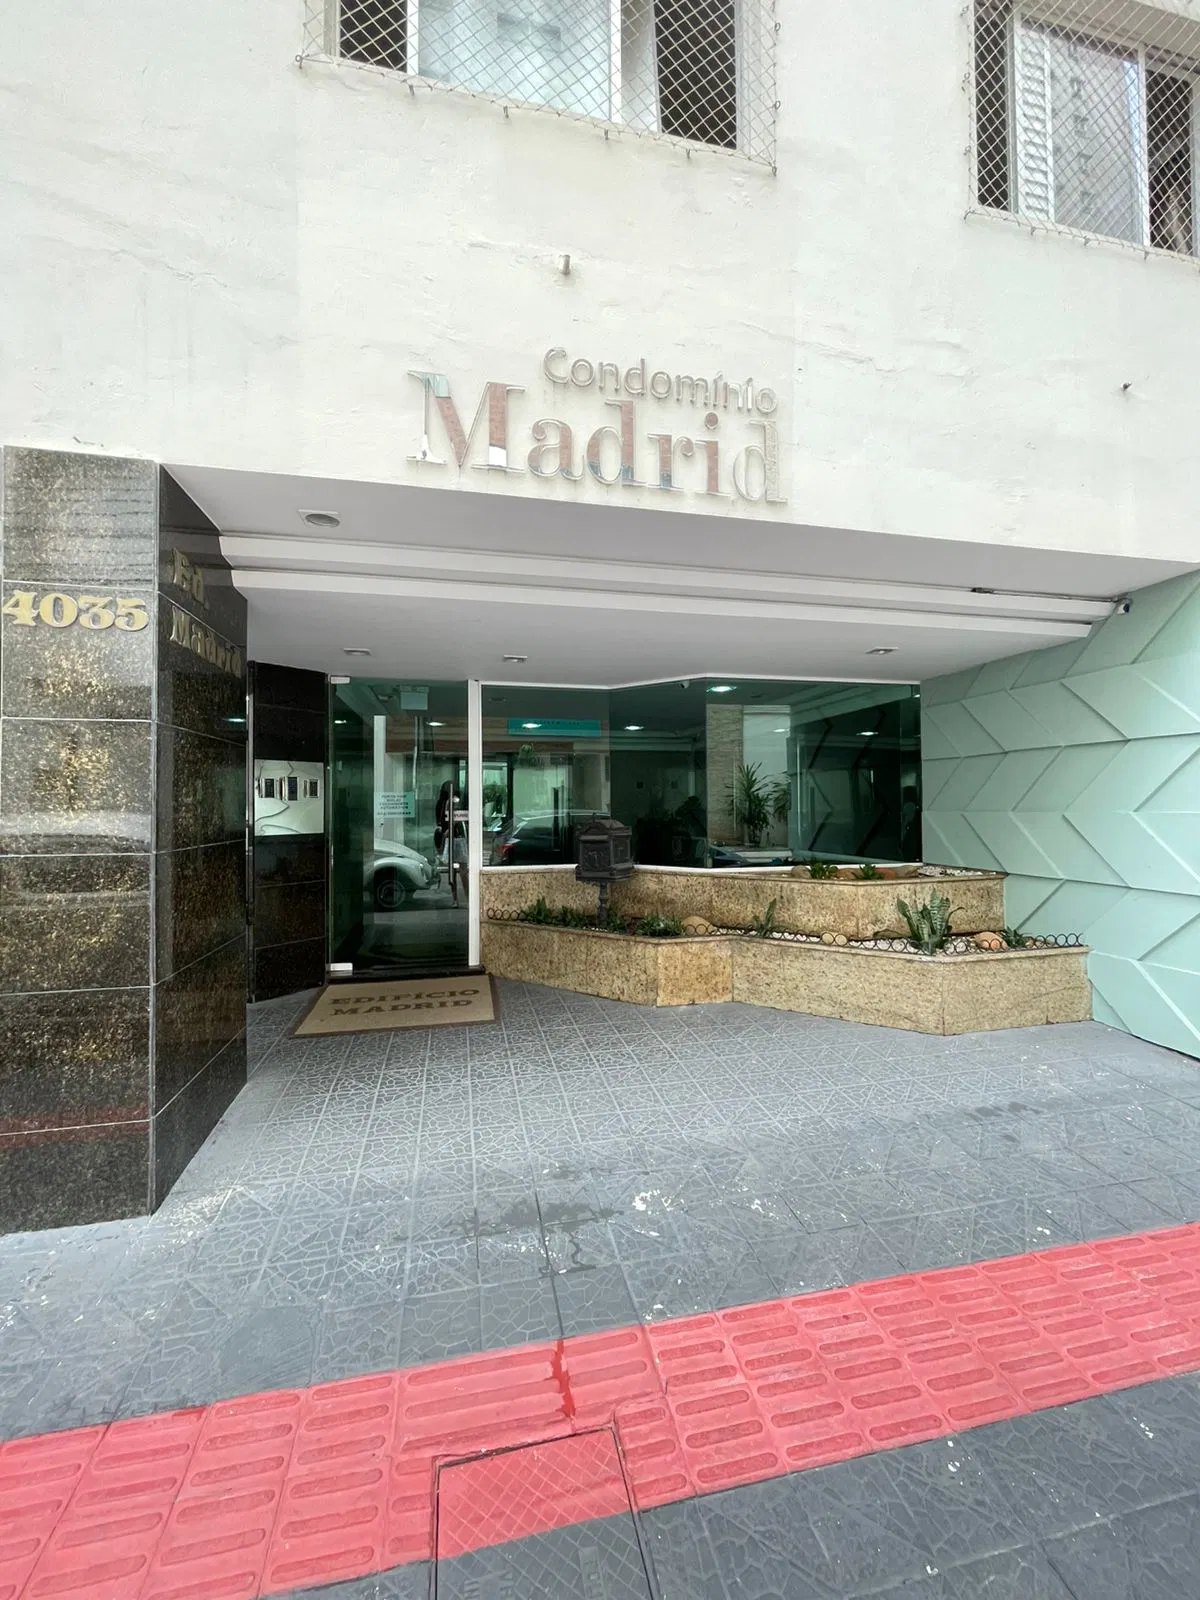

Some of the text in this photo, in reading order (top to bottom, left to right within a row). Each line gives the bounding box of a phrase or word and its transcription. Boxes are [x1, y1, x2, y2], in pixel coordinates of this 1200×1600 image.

[405, 370, 789, 505] Madrid
[1, 589, 149, 632] 4035
[328, 988, 480, 1005] EDIFICIO
[330, 1000, 473, 1017] MADRID
